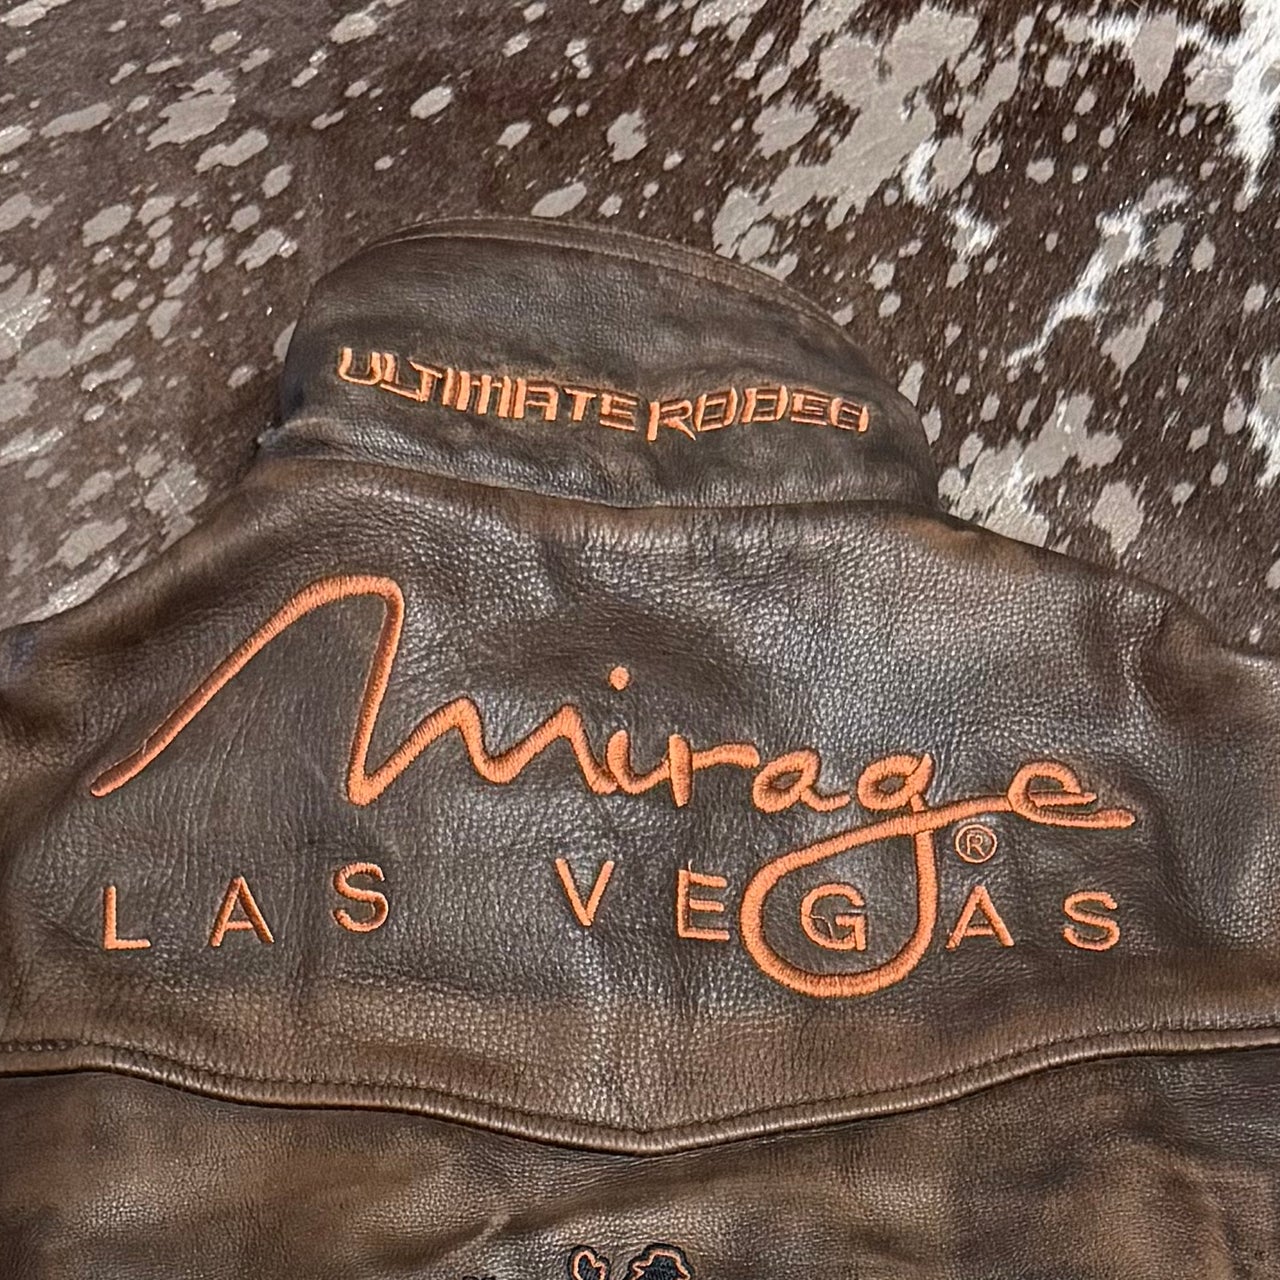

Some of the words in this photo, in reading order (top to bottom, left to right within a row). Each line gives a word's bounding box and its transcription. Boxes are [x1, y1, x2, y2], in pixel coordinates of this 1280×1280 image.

[337, 346, 638, 432] ULTIMATE
[646, 385, 872, 442] RODEO
[90, 574, 1136, 998] Mirage
[104, 861, 390, 949] LAS
[558, 856, 1121, 951] VEGAS
